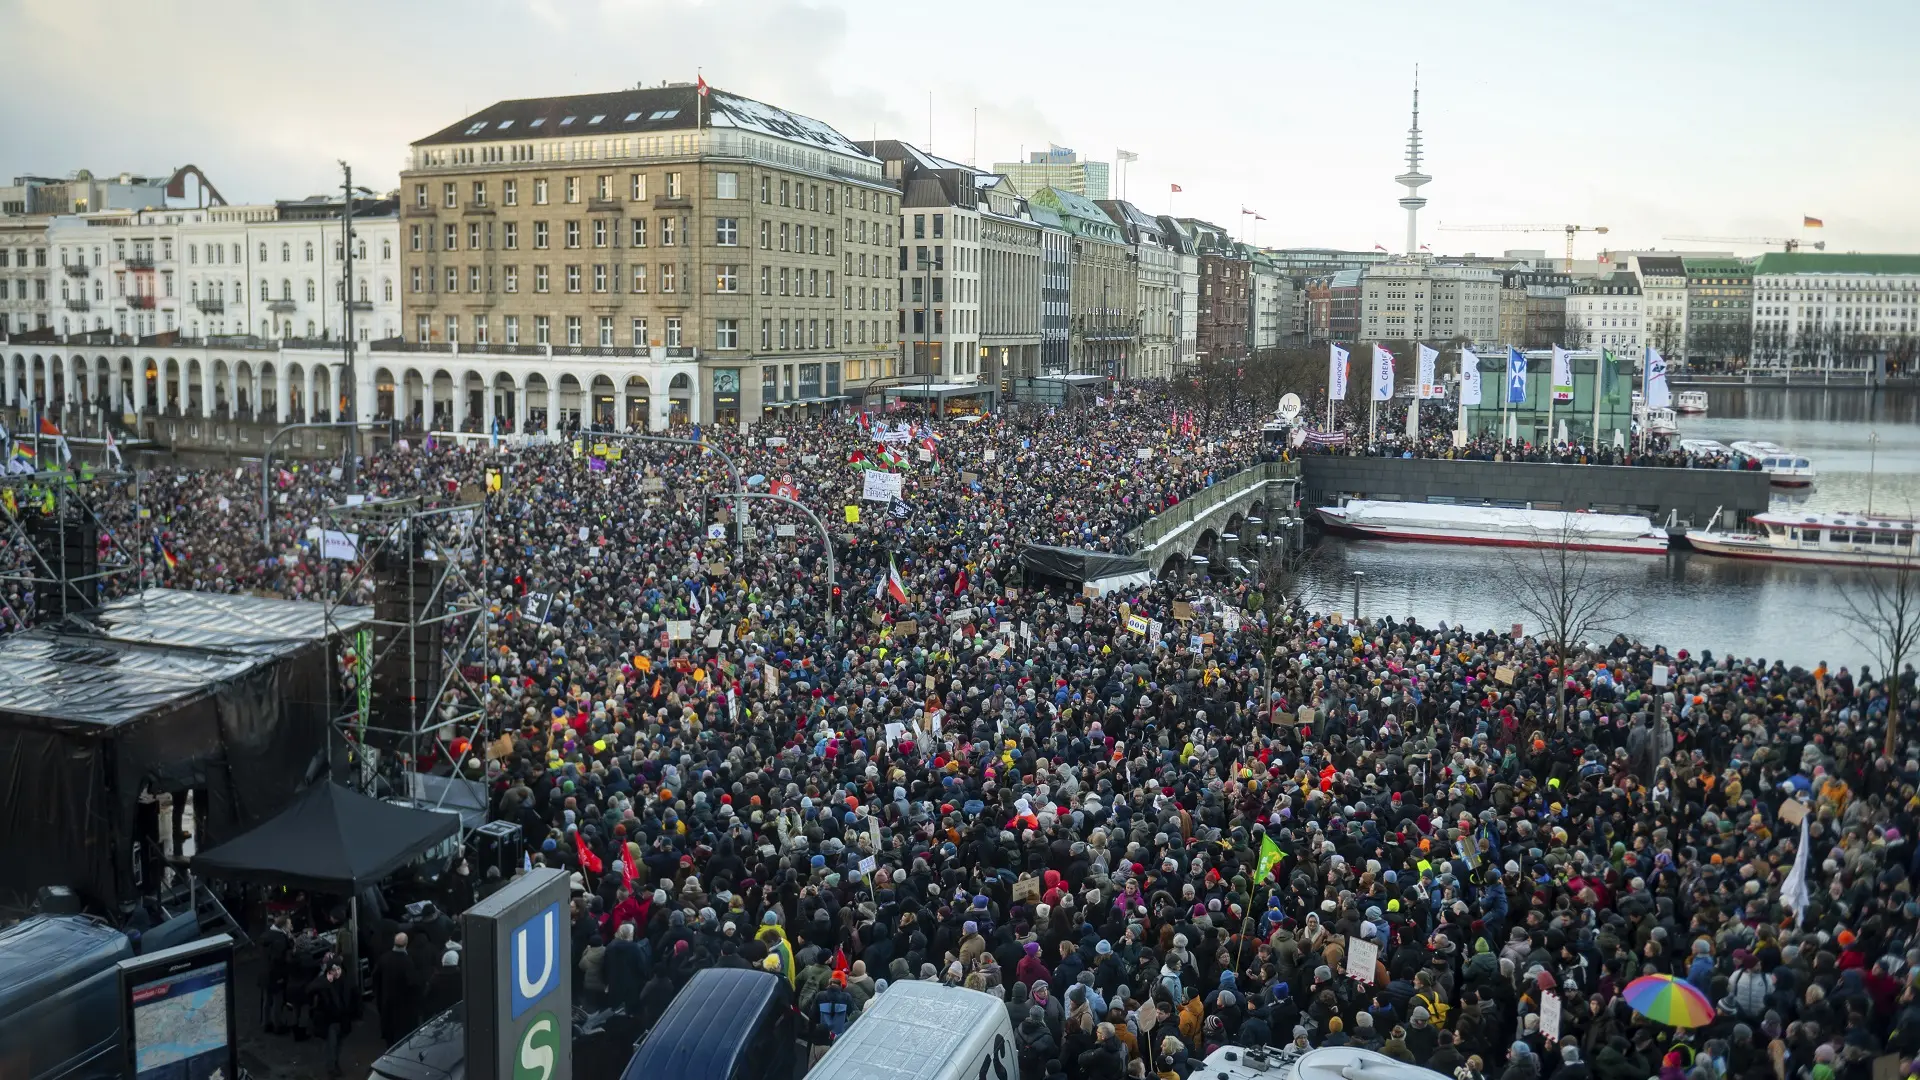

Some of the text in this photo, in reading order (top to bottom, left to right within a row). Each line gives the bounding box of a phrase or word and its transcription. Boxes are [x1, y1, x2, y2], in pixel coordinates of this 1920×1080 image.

[1282, 404, 1297, 412] NDR
[518, 911, 553, 999] U
[521, 1019, 554, 1080] S
